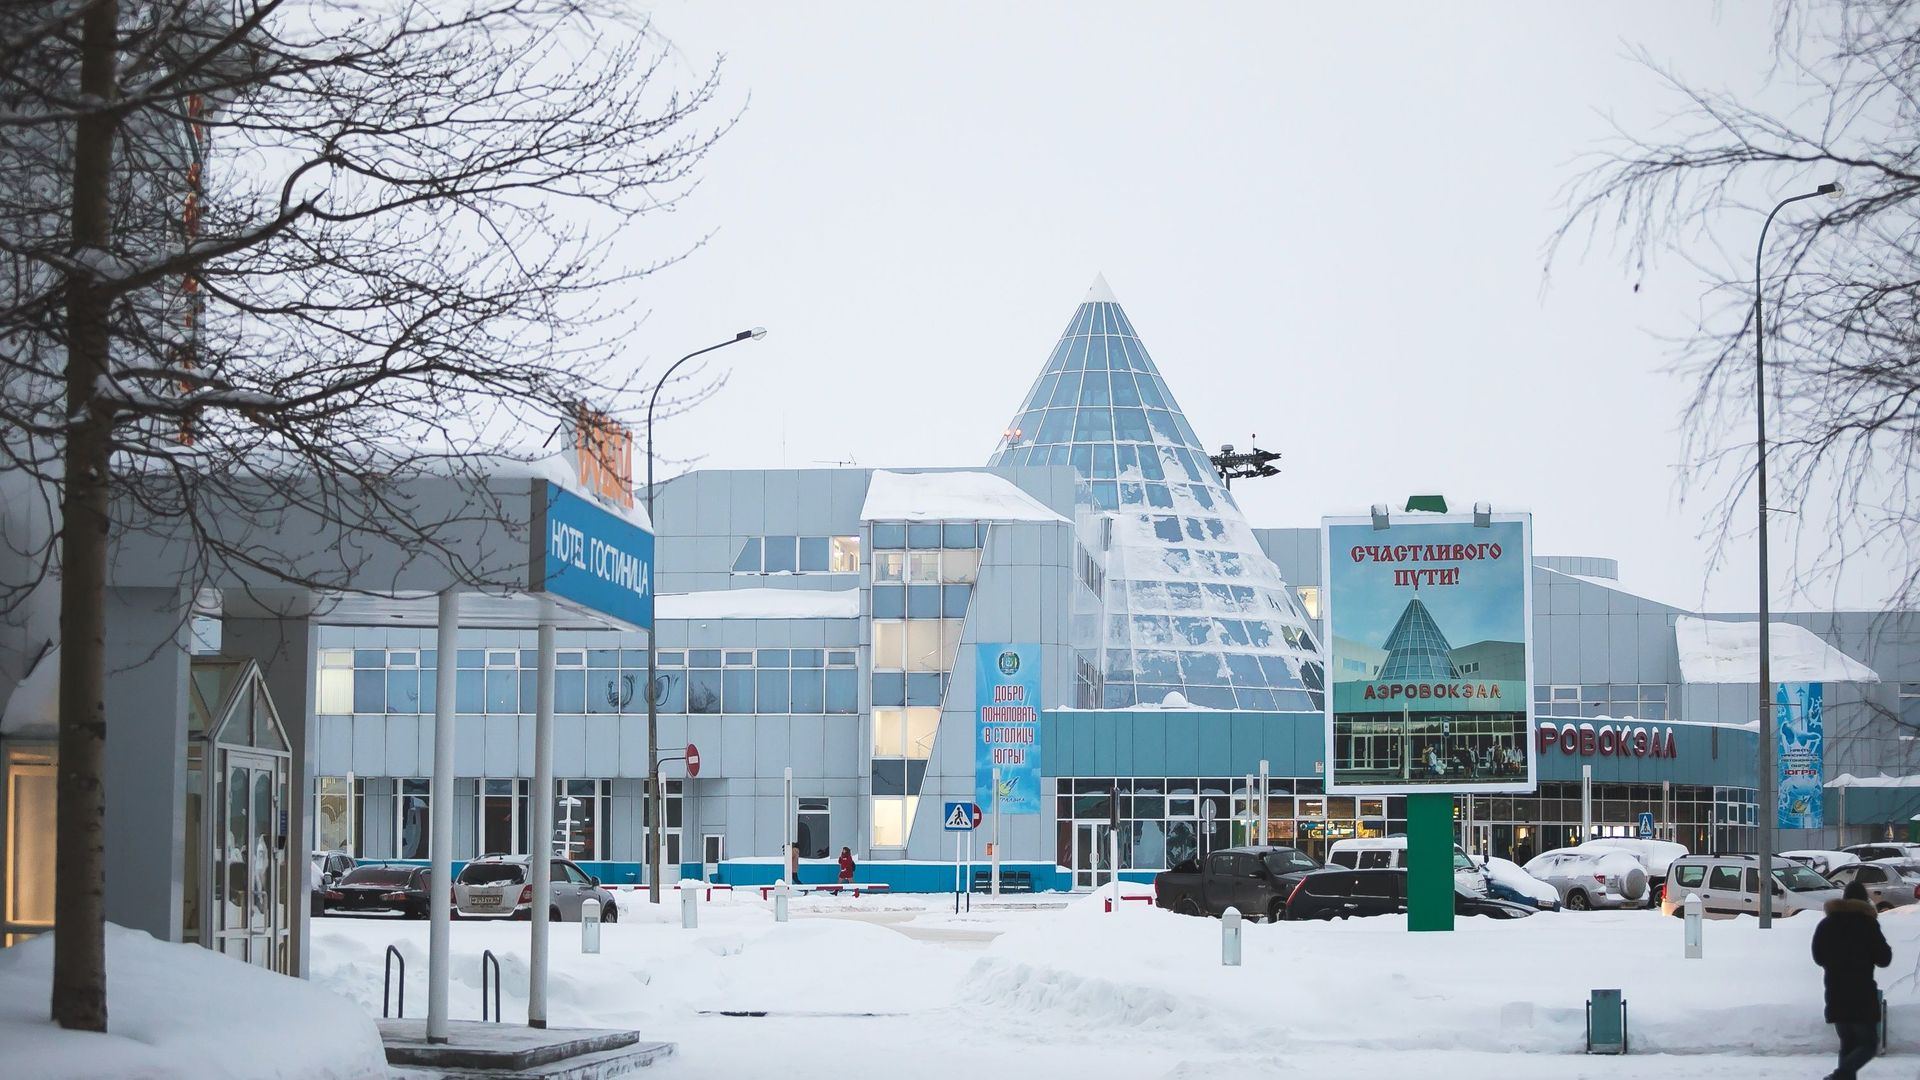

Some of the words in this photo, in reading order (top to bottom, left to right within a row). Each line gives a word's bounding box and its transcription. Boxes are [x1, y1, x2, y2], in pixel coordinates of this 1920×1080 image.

[552, 519, 586, 570] HOTEL
[590, 537, 649, 599] ГОСТИНИЦА
[1351, 543, 1502, 563] СЧАСТЛИВОГО
[1394, 567, 1460, 590] ПУТИ!
[994, 686, 1024, 703] ДОБРО
[1364, 684, 1502, 700] АЭРОВОКЗАЛ
[982, 706, 1037, 722] ПОЖАЛОВАТЬ
[985, 728, 991, 743] В
[994, 728, 1034, 745] СТОЛИЦУ
[1535, 723, 1677, 758] РОВОКЗАЛ
[993, 749, 1025, 764] ЮГРЫ!
